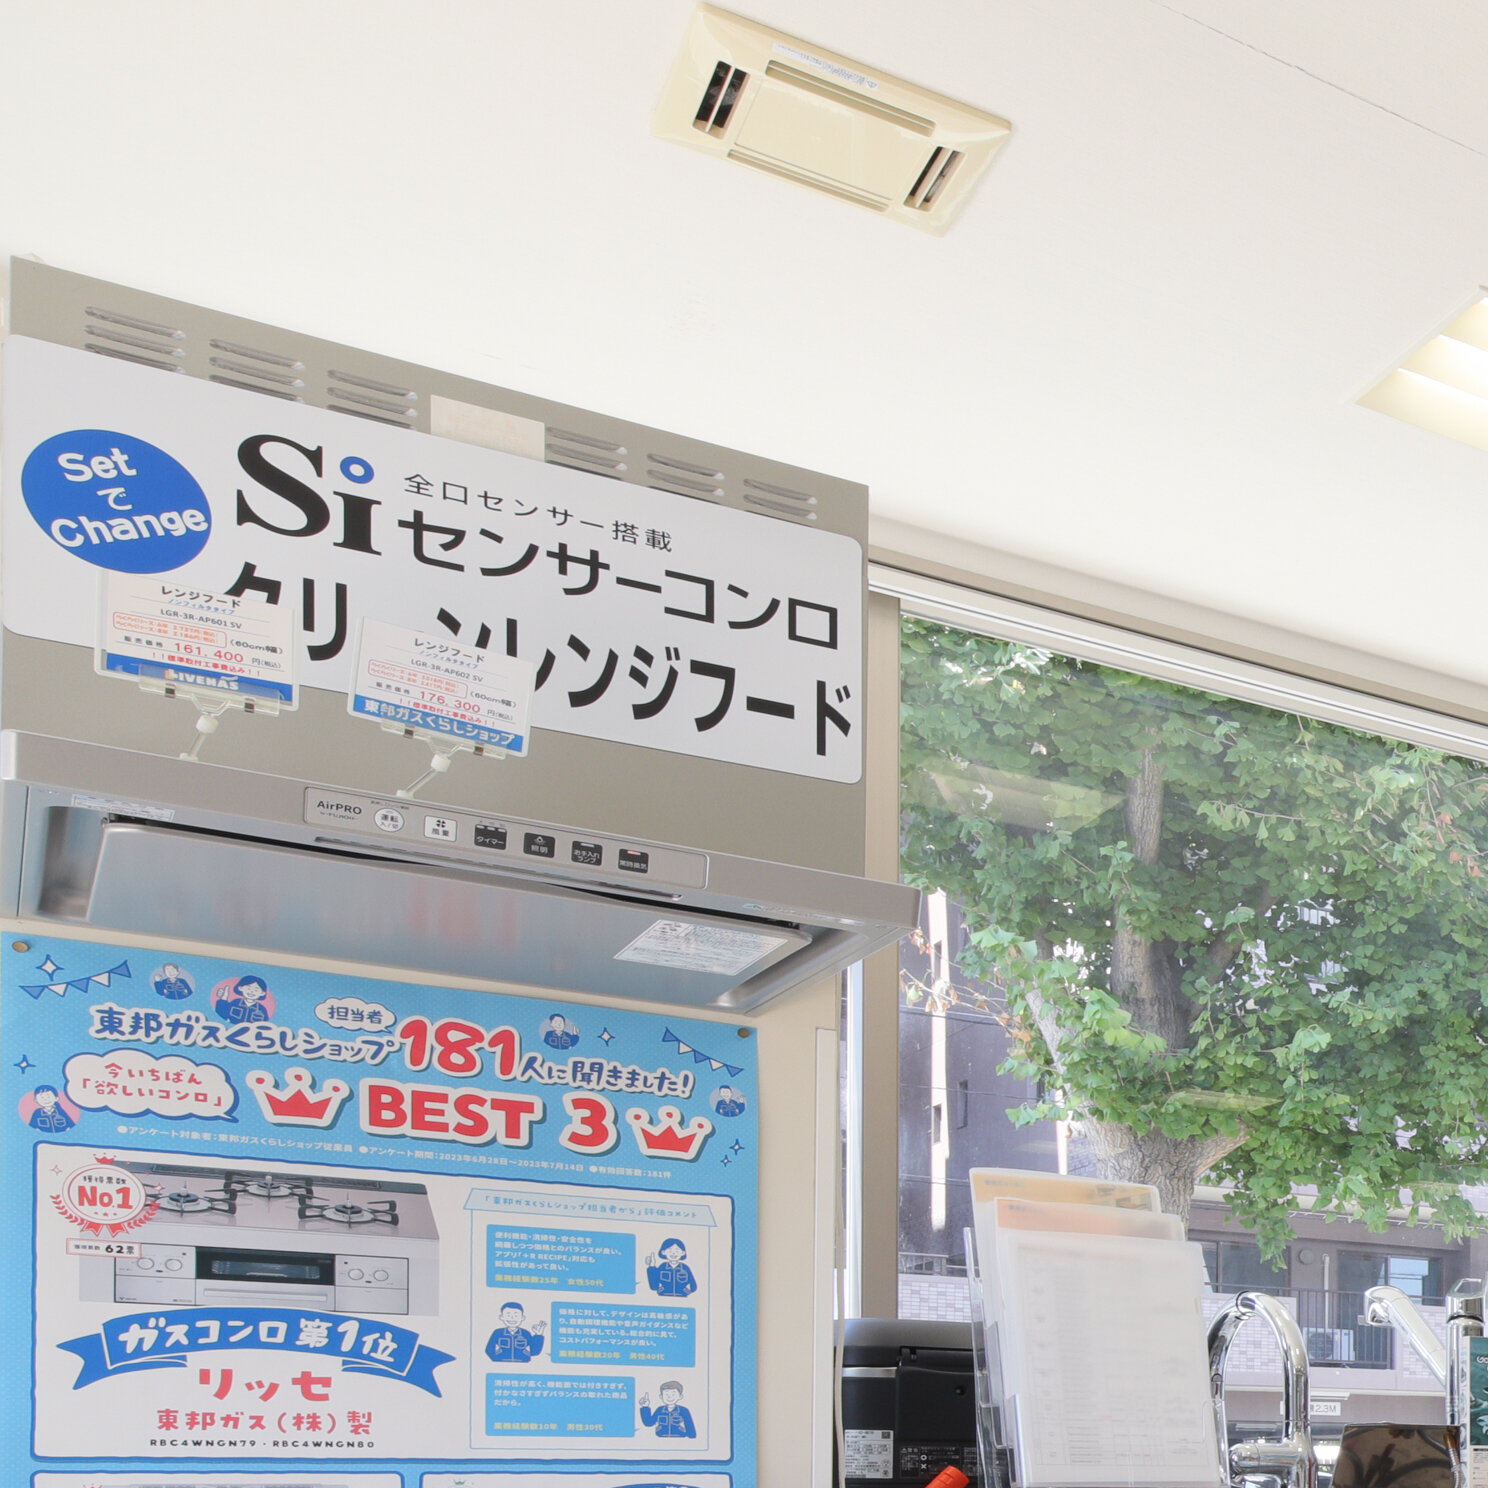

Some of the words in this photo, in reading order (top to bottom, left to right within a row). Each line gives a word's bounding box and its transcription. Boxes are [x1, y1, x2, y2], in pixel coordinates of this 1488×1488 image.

[57, 447, 137, 482] Set
[97, 488, 132, 511] で
[237, 434, 382, 555] Si
[403, 473, 672, 552] 全口センサー搭載
[50, 508, 209, 549] Change
[398, 509, 838, 650] センサーコンロ
[161, 585, 241, 608] レンジフード
[160, 609, 228, 627] LGR-3R-AP601
[414, 638, 485, 663] レンジフード
[411, 659, 470, 680] LGR-3R-AP602
[317, 799, 362, 815] AirPRO
[327, 1004, 383, 1025] 担当者
[94, 1006, 396, 1061] 東邦ガスくらしショップ
[400, 1019, 517, 1077] 181
[104, 1062, 203, 1085] 今いちばん
[82, 1077, 223, 1107] 「欲しいコンロ」
[368, 1084, 535, 1140] BEST
[567, 1097, 609, 1148] 3
[77, 1185, 134, 1210] No.1
[118, 1316, 287, 1355] ガスコンロ
[296, 1318, 399, 1362] 第1位
[199, 1368, 332, 1402] リッセ
[157, 1408, 374, 1437] 東邦ガス（株）製
[150, 1438, 257, 1449] RBC4WNGN79
